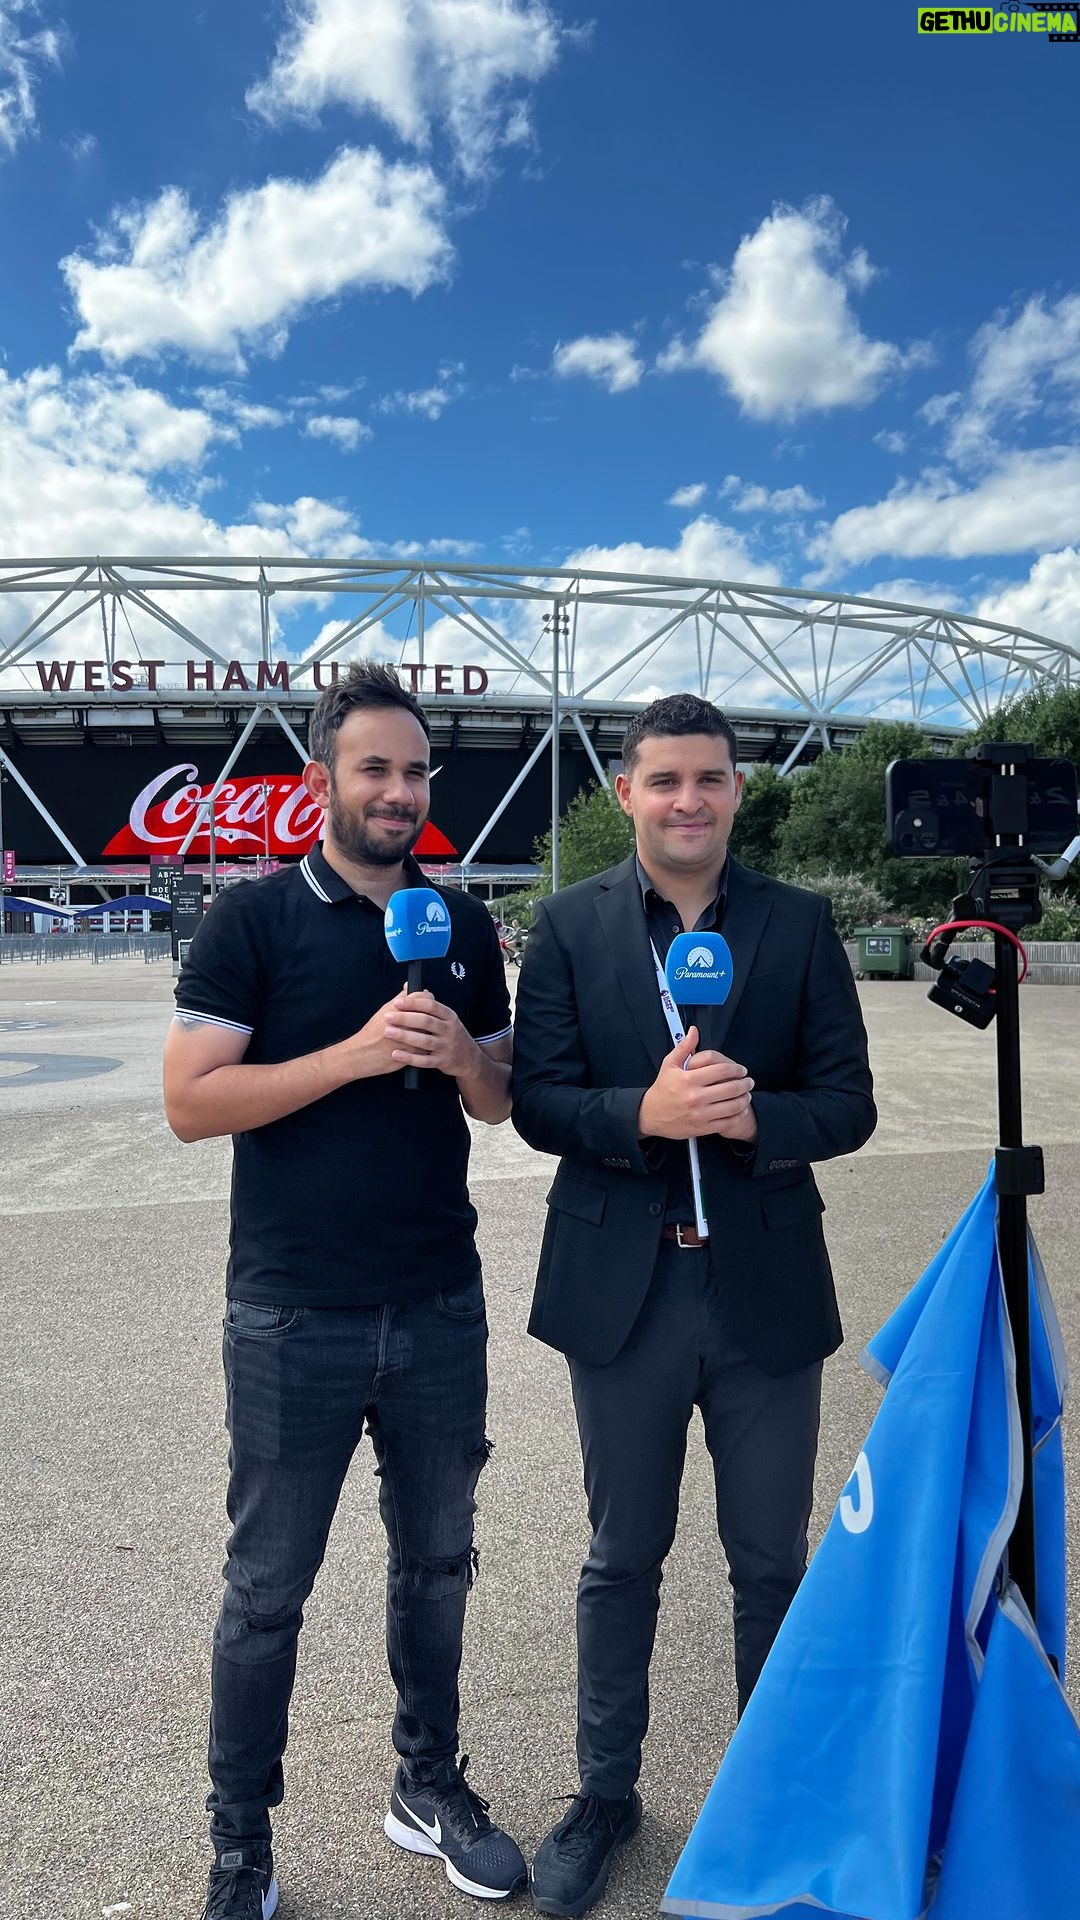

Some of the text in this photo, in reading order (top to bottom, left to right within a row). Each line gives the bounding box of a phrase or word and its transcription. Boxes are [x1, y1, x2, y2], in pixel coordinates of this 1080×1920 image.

[36, 660, 489, 695] WEST HAM UTED
[674, 966, 726, 980] Paramount+
